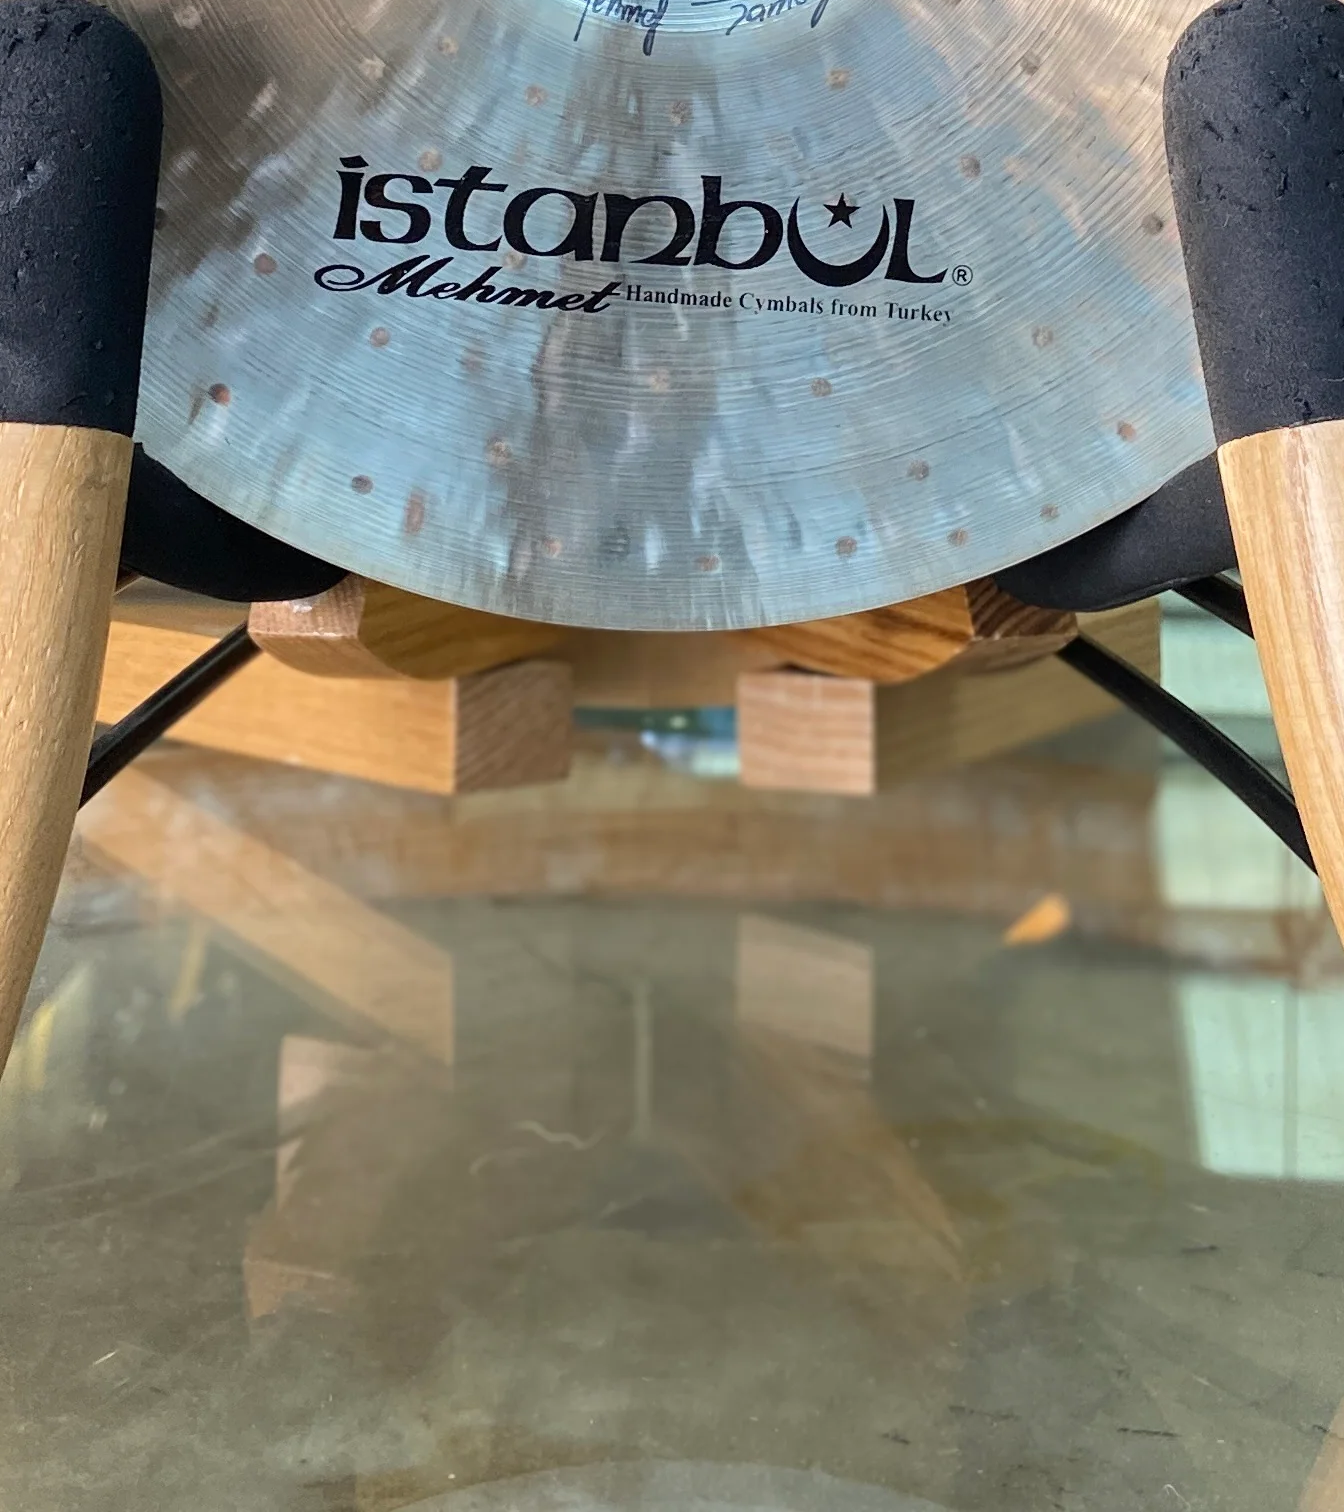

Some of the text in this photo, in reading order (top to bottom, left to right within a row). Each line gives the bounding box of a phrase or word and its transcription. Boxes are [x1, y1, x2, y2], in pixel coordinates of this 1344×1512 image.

[314, 254, 623, 314] Mehmet
[626, 284, 953, 328] Handmade Cymbals from Turkey
